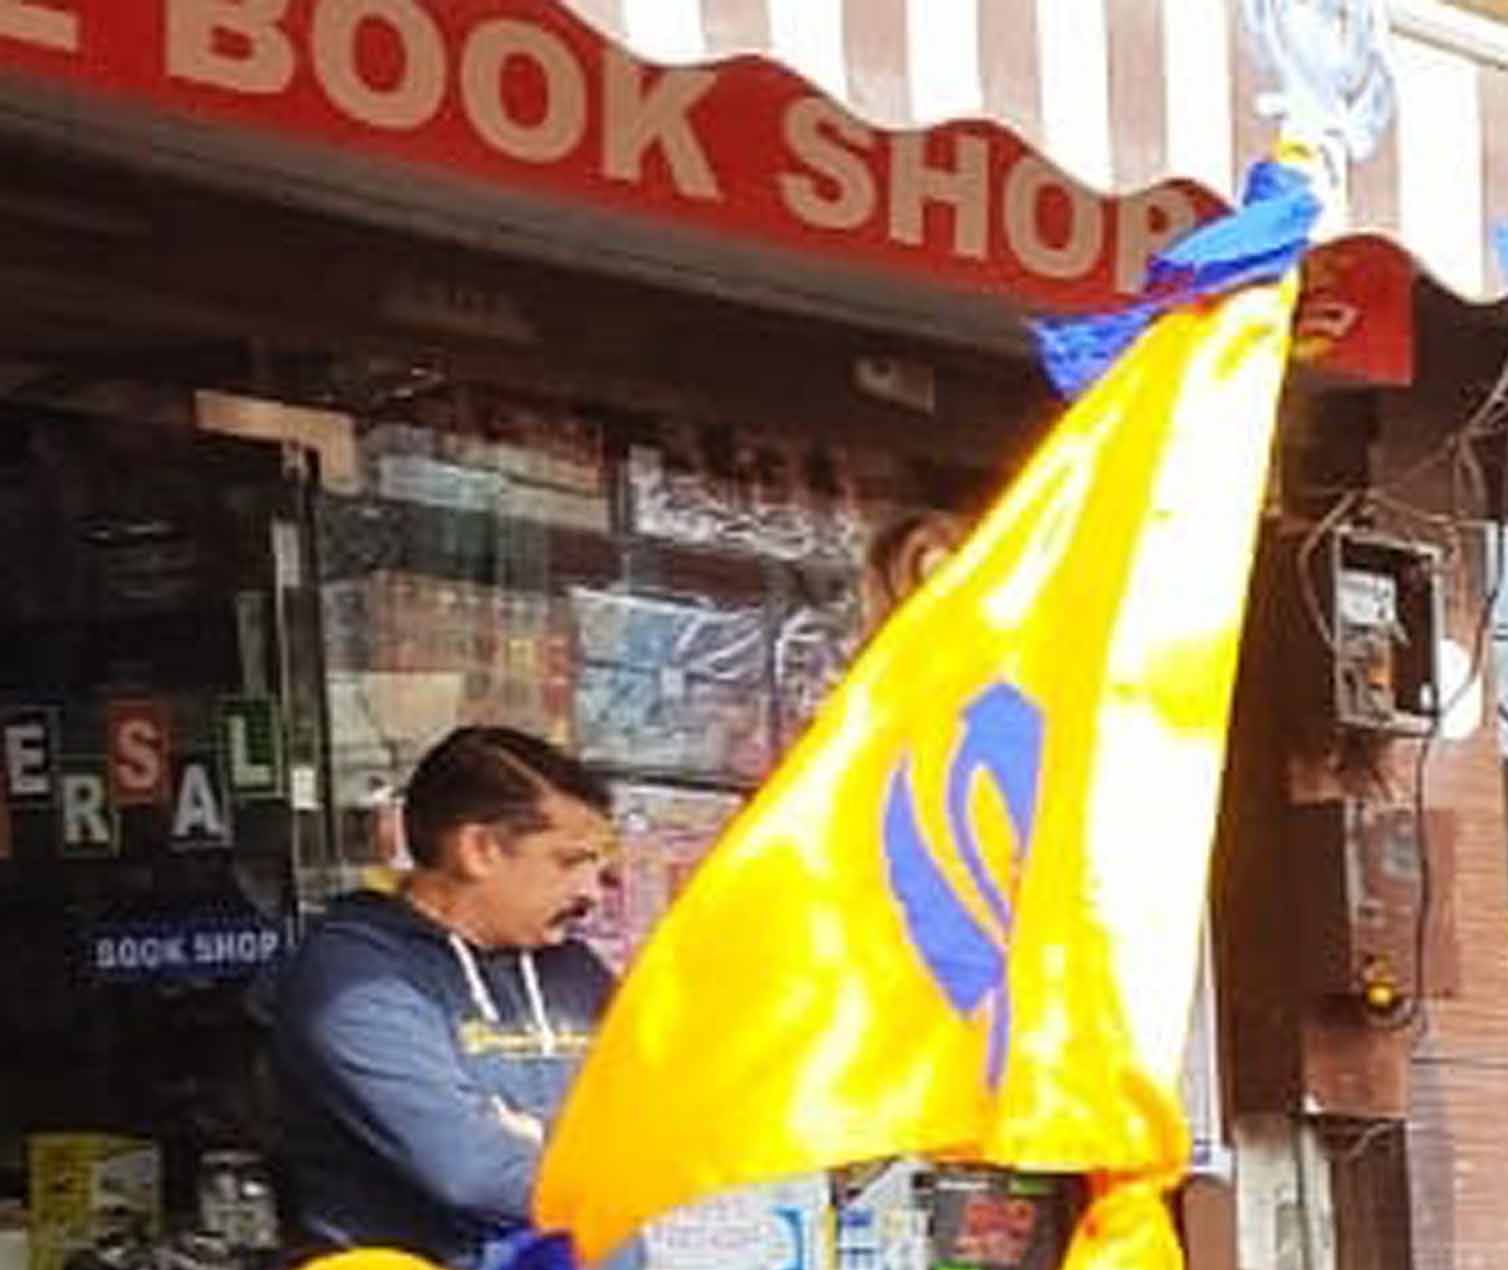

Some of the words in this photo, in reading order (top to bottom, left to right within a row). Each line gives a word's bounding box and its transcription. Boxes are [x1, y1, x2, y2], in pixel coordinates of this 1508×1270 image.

[163, 0, 720, 201] BOOK
[96, 937, 188, 970] BOOK
[193, 930, 280, 964] SHOP
